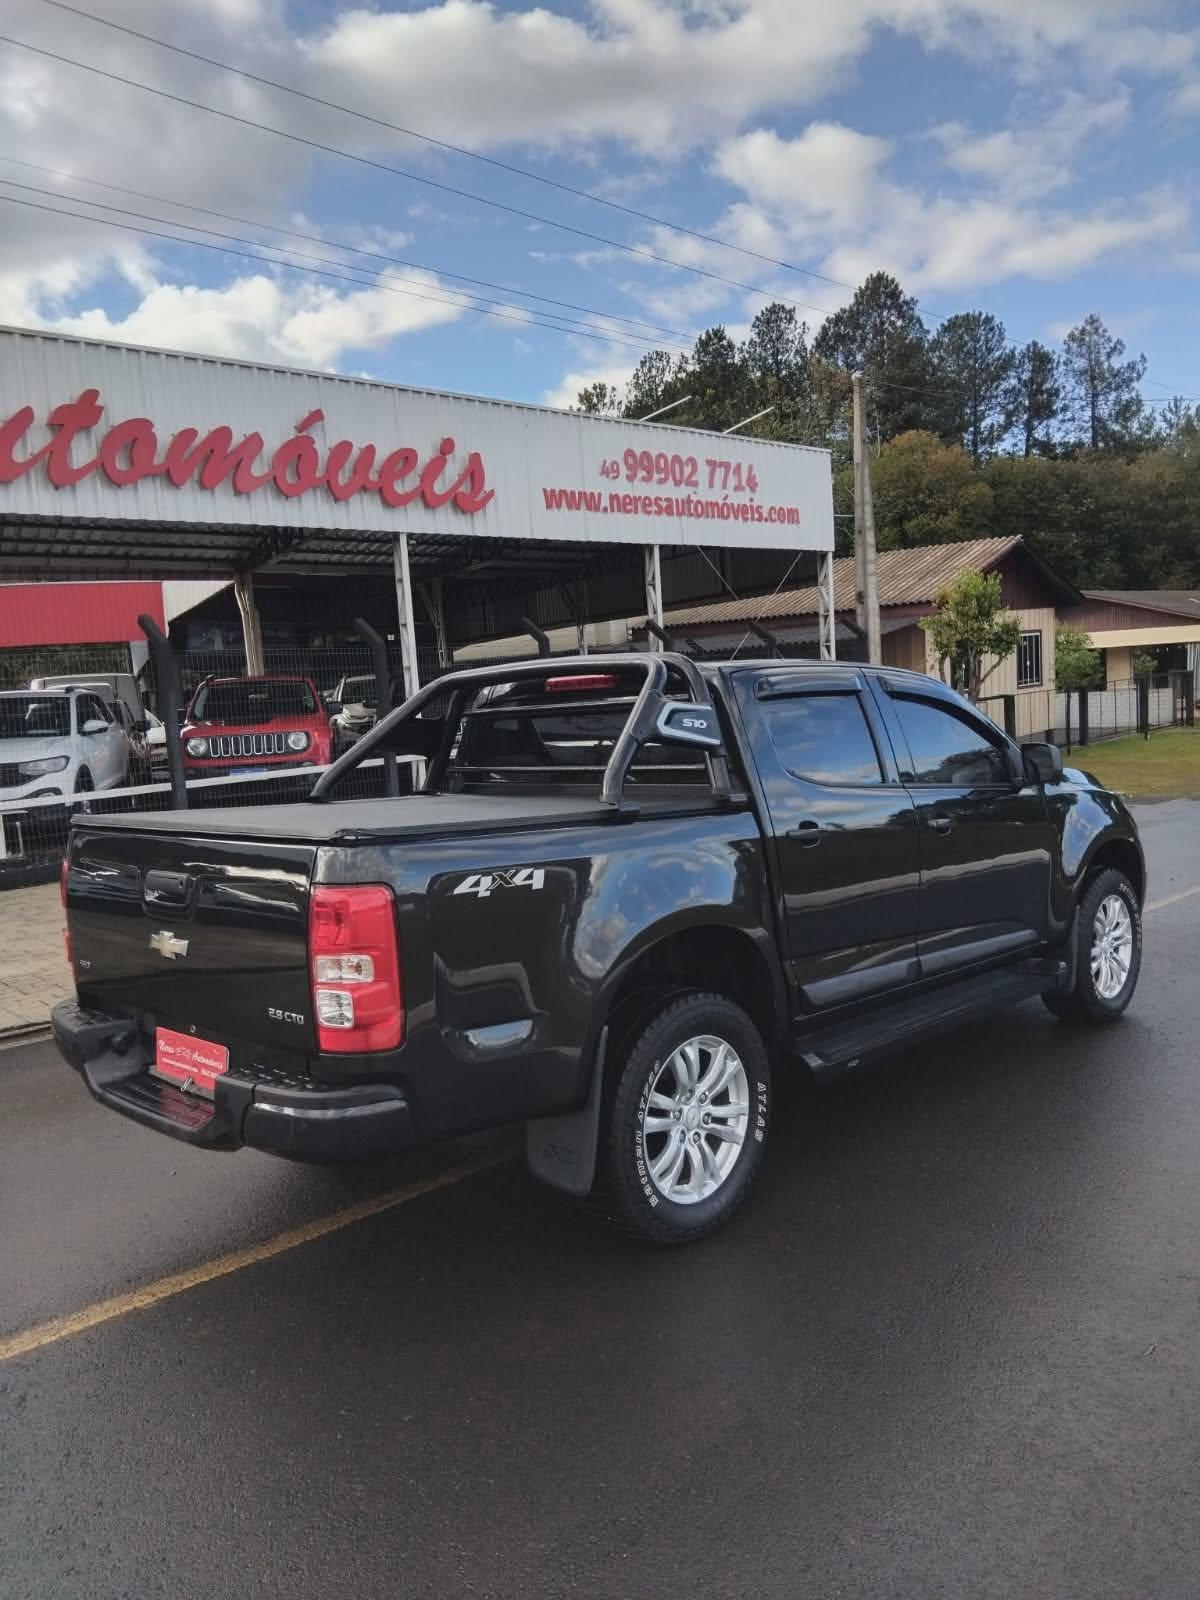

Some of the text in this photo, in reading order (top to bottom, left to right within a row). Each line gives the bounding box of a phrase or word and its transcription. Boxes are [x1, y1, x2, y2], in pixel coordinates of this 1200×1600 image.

[599, 447, 758, 493] 49 99902 7714
[543, 487, 800, 525] www.neresautomóveis.com
[682, 718, 707, 729] S10
[754, 1082, 767, 1142] ATLAS
